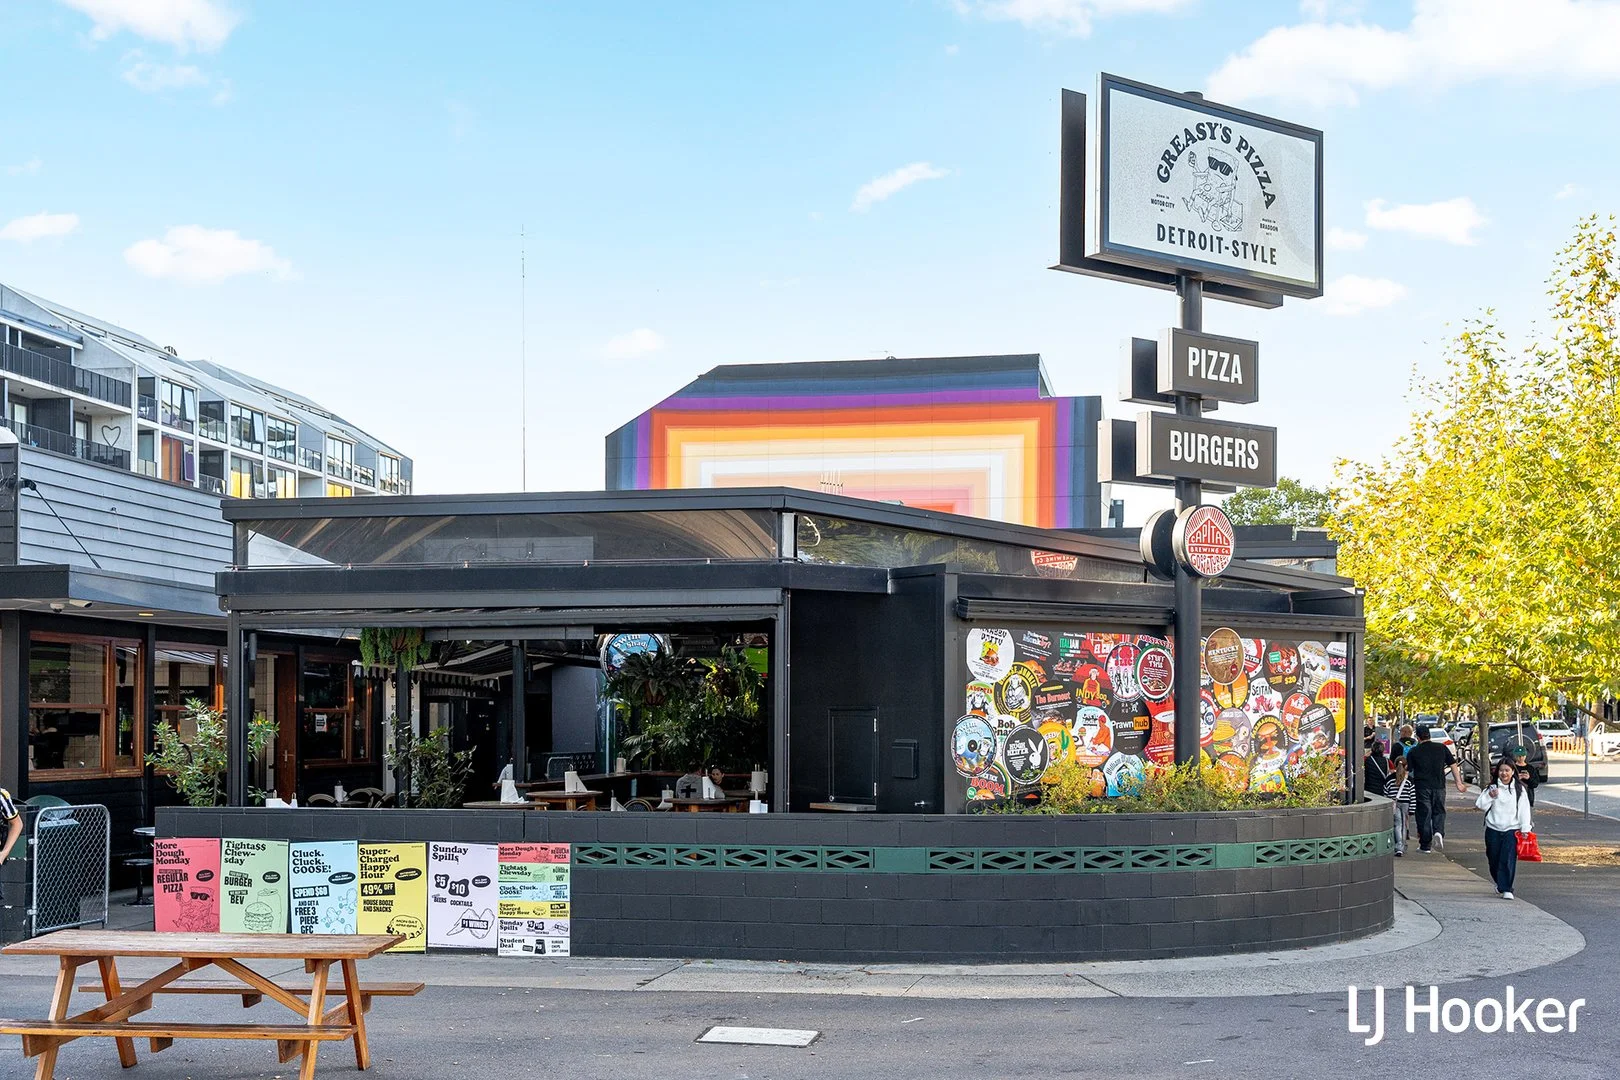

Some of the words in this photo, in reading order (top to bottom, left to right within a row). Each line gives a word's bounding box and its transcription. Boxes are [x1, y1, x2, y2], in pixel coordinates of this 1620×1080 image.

[1157, 122, 1232, 183] GREASY'S
[1235, 135, 1276, 210] PIZZA
[1156, 223, 1277, 265] DETROIT-STYLE
[1188, 346, 1243, 384] PIZZA
[1170, 430, 1259, 470] BURGERS
[1191, 520, 1228, 546] CAPITAL
[1208, 645, 1239, 656] KENTUCKY
[1076, 688, 1095, 700] INDY
[1035, 695, 1046, 704] The
[998, 719, 1015, 728] Bob
[1134, 717, 1148, 728] hub
[971, 778, 1004, 795] BOOM
[156, 849, 184, 858] Dough
[292, 850, 324, 858] Cluck.
[360, 848, 391, 857] Super-
[432, 844, 468, 855] Sunday
[156, 857, 190, 866] Monday
[224, 857, 245, 866] sday
[360, 855, 400, 864] Charged
[432, 853, 459, 862] Spills
[293, 865, 332, 874] GOOSE!
[360, 864, 391, 872] Happy
[157, 872, 188, 884] REGULAR
[224, 876, 253, 887] BURGER
[437, 876, 446, 887] $5
[163, 883, 183, 893] PIZZA
[294, 888, 315, 898] SPEND
[363, 885, 382, 895] 49%
[452, 883, 465, 894] $10
[230, 895, 244, 905] BEV
[295, 907, 311, 916] FREE
[311, 907, 316, 915] 3
[300, 916, 319, 925] PIECE
[301, 926, 314, 934] GFC
